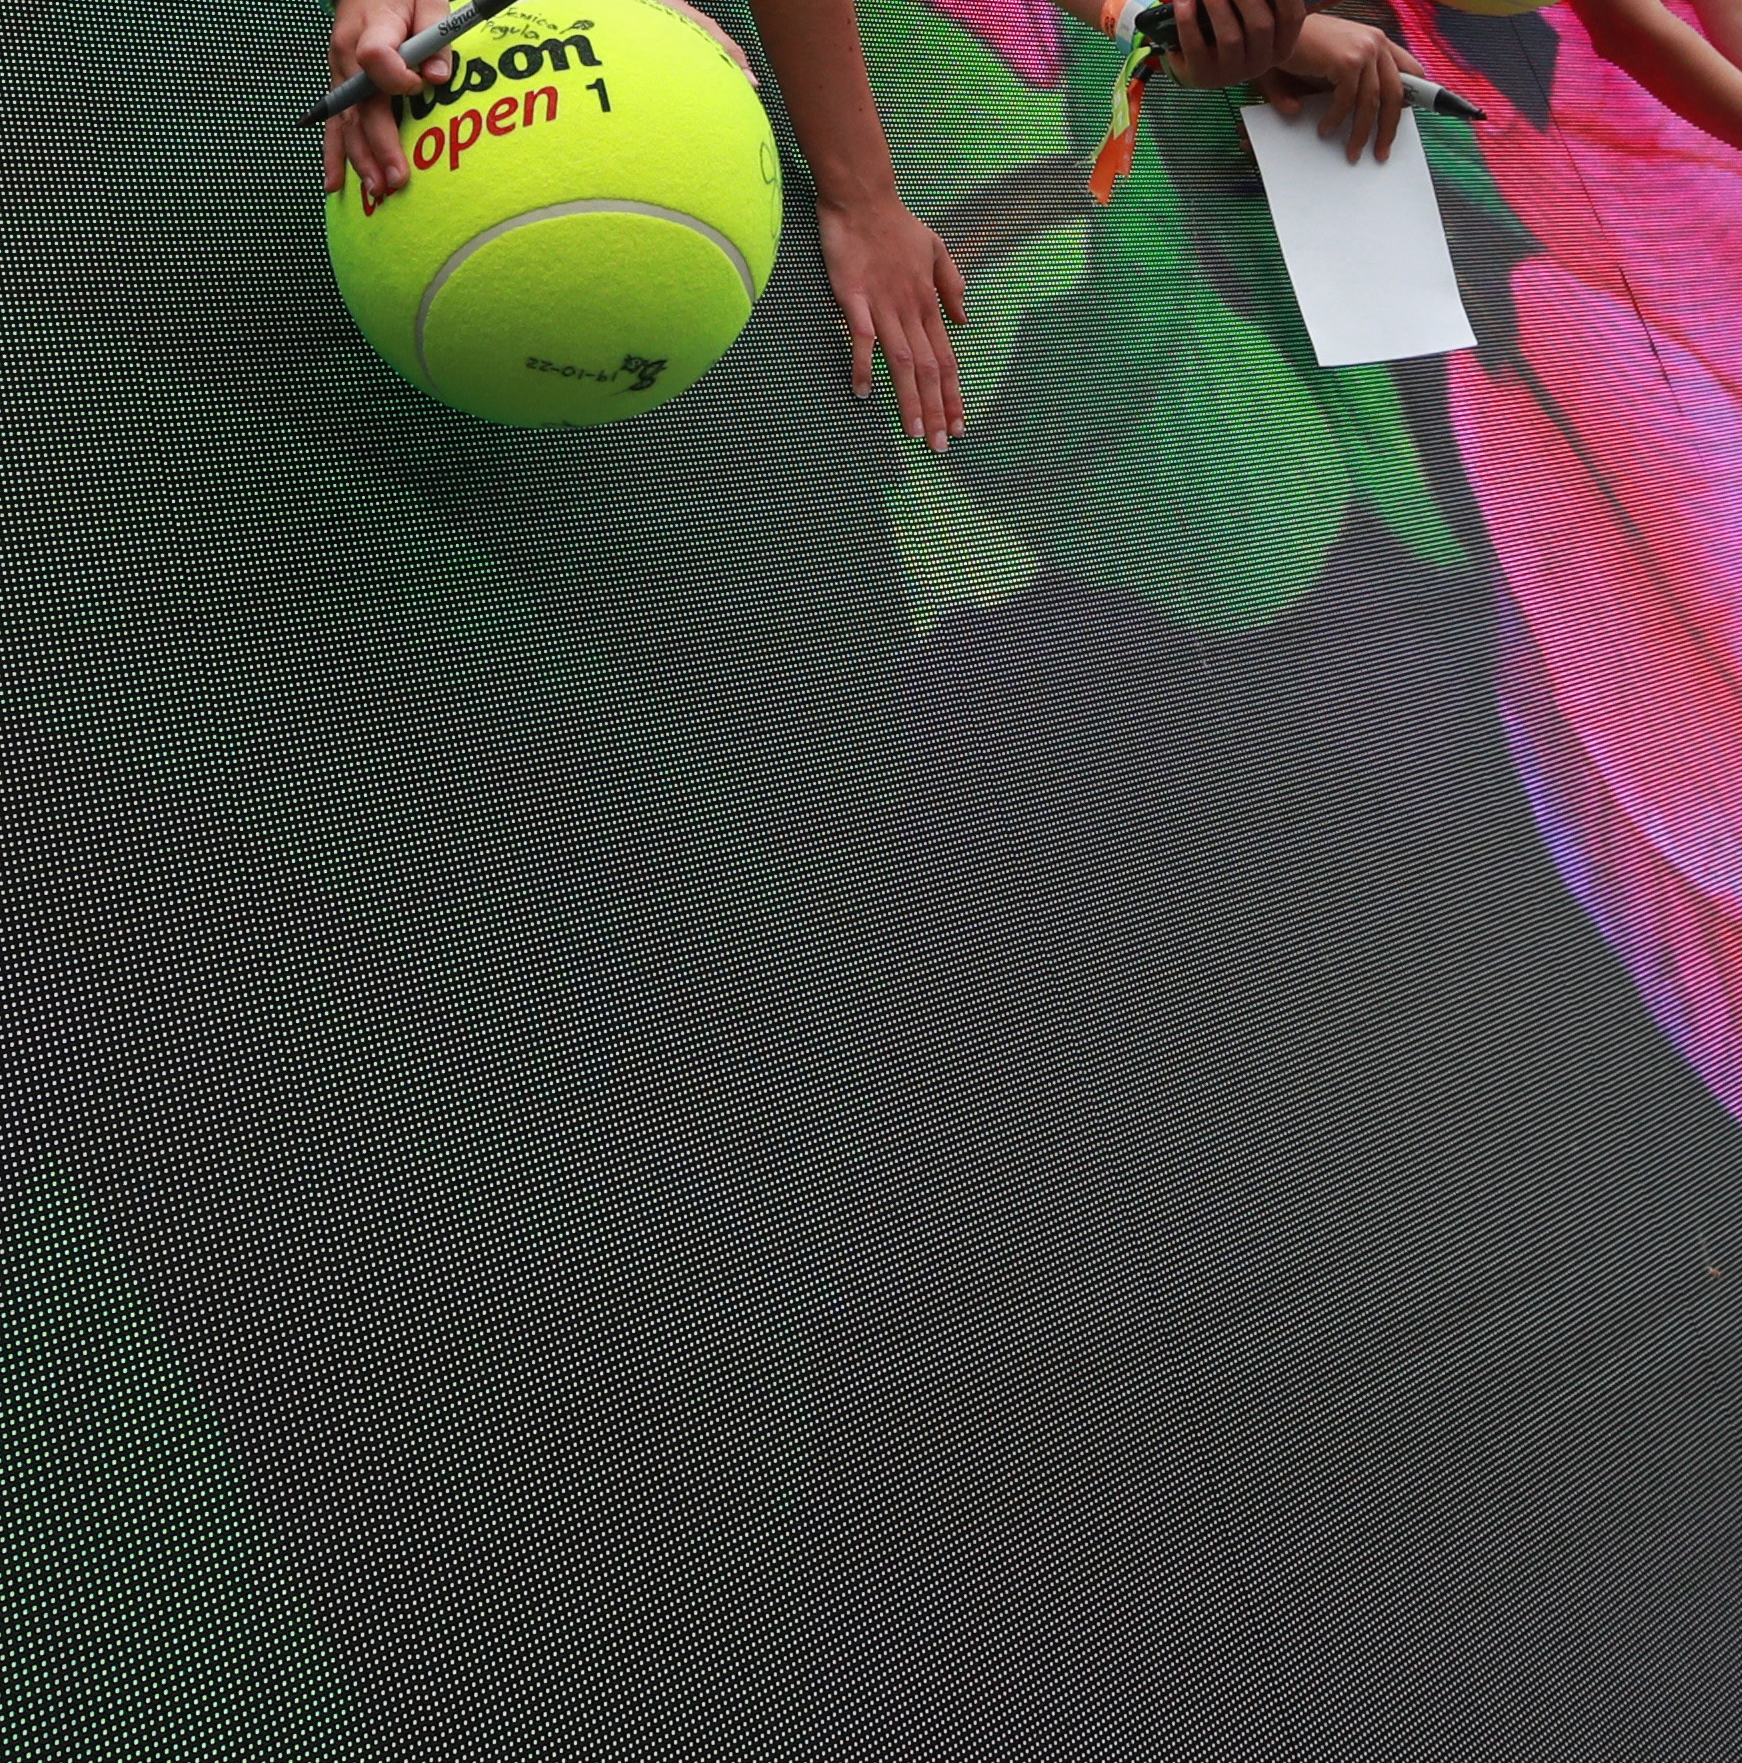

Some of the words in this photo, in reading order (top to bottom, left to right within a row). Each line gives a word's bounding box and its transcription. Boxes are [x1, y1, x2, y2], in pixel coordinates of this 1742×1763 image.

[391, 34, 603, 128] ilson
[413, 85, 558, 172] open
[586, 77, 611, 113] 1
